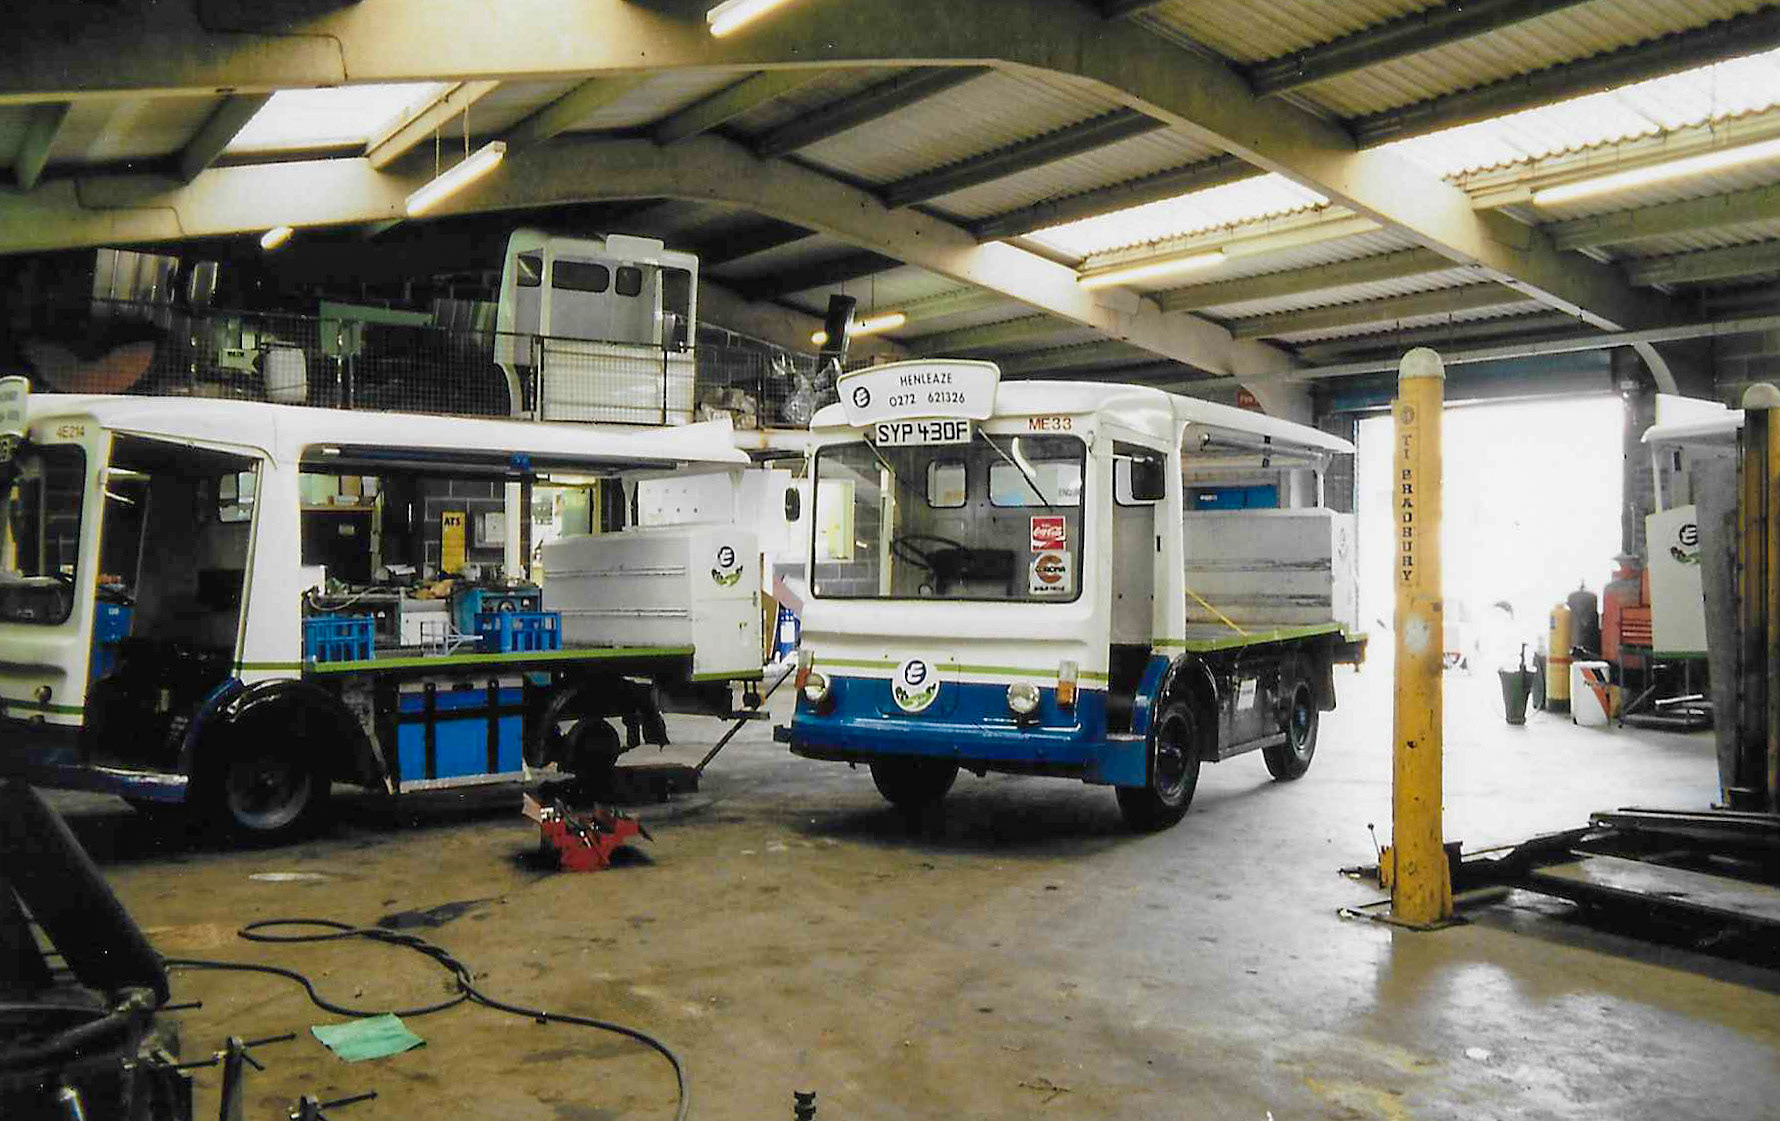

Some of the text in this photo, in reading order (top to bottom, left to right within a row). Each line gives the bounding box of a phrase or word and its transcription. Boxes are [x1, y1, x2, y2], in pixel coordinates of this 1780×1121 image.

[899, 372, 953, 387] HENLEAZE
[888, 391, 966, 407] 0272 621326
[1028, 417, 1073, 431] ME33
[877, 421, 969, 444] SYP 430F
[444, 516, 461, 527] ATS
[1401, 468, 1414, 582] BRADBURY
